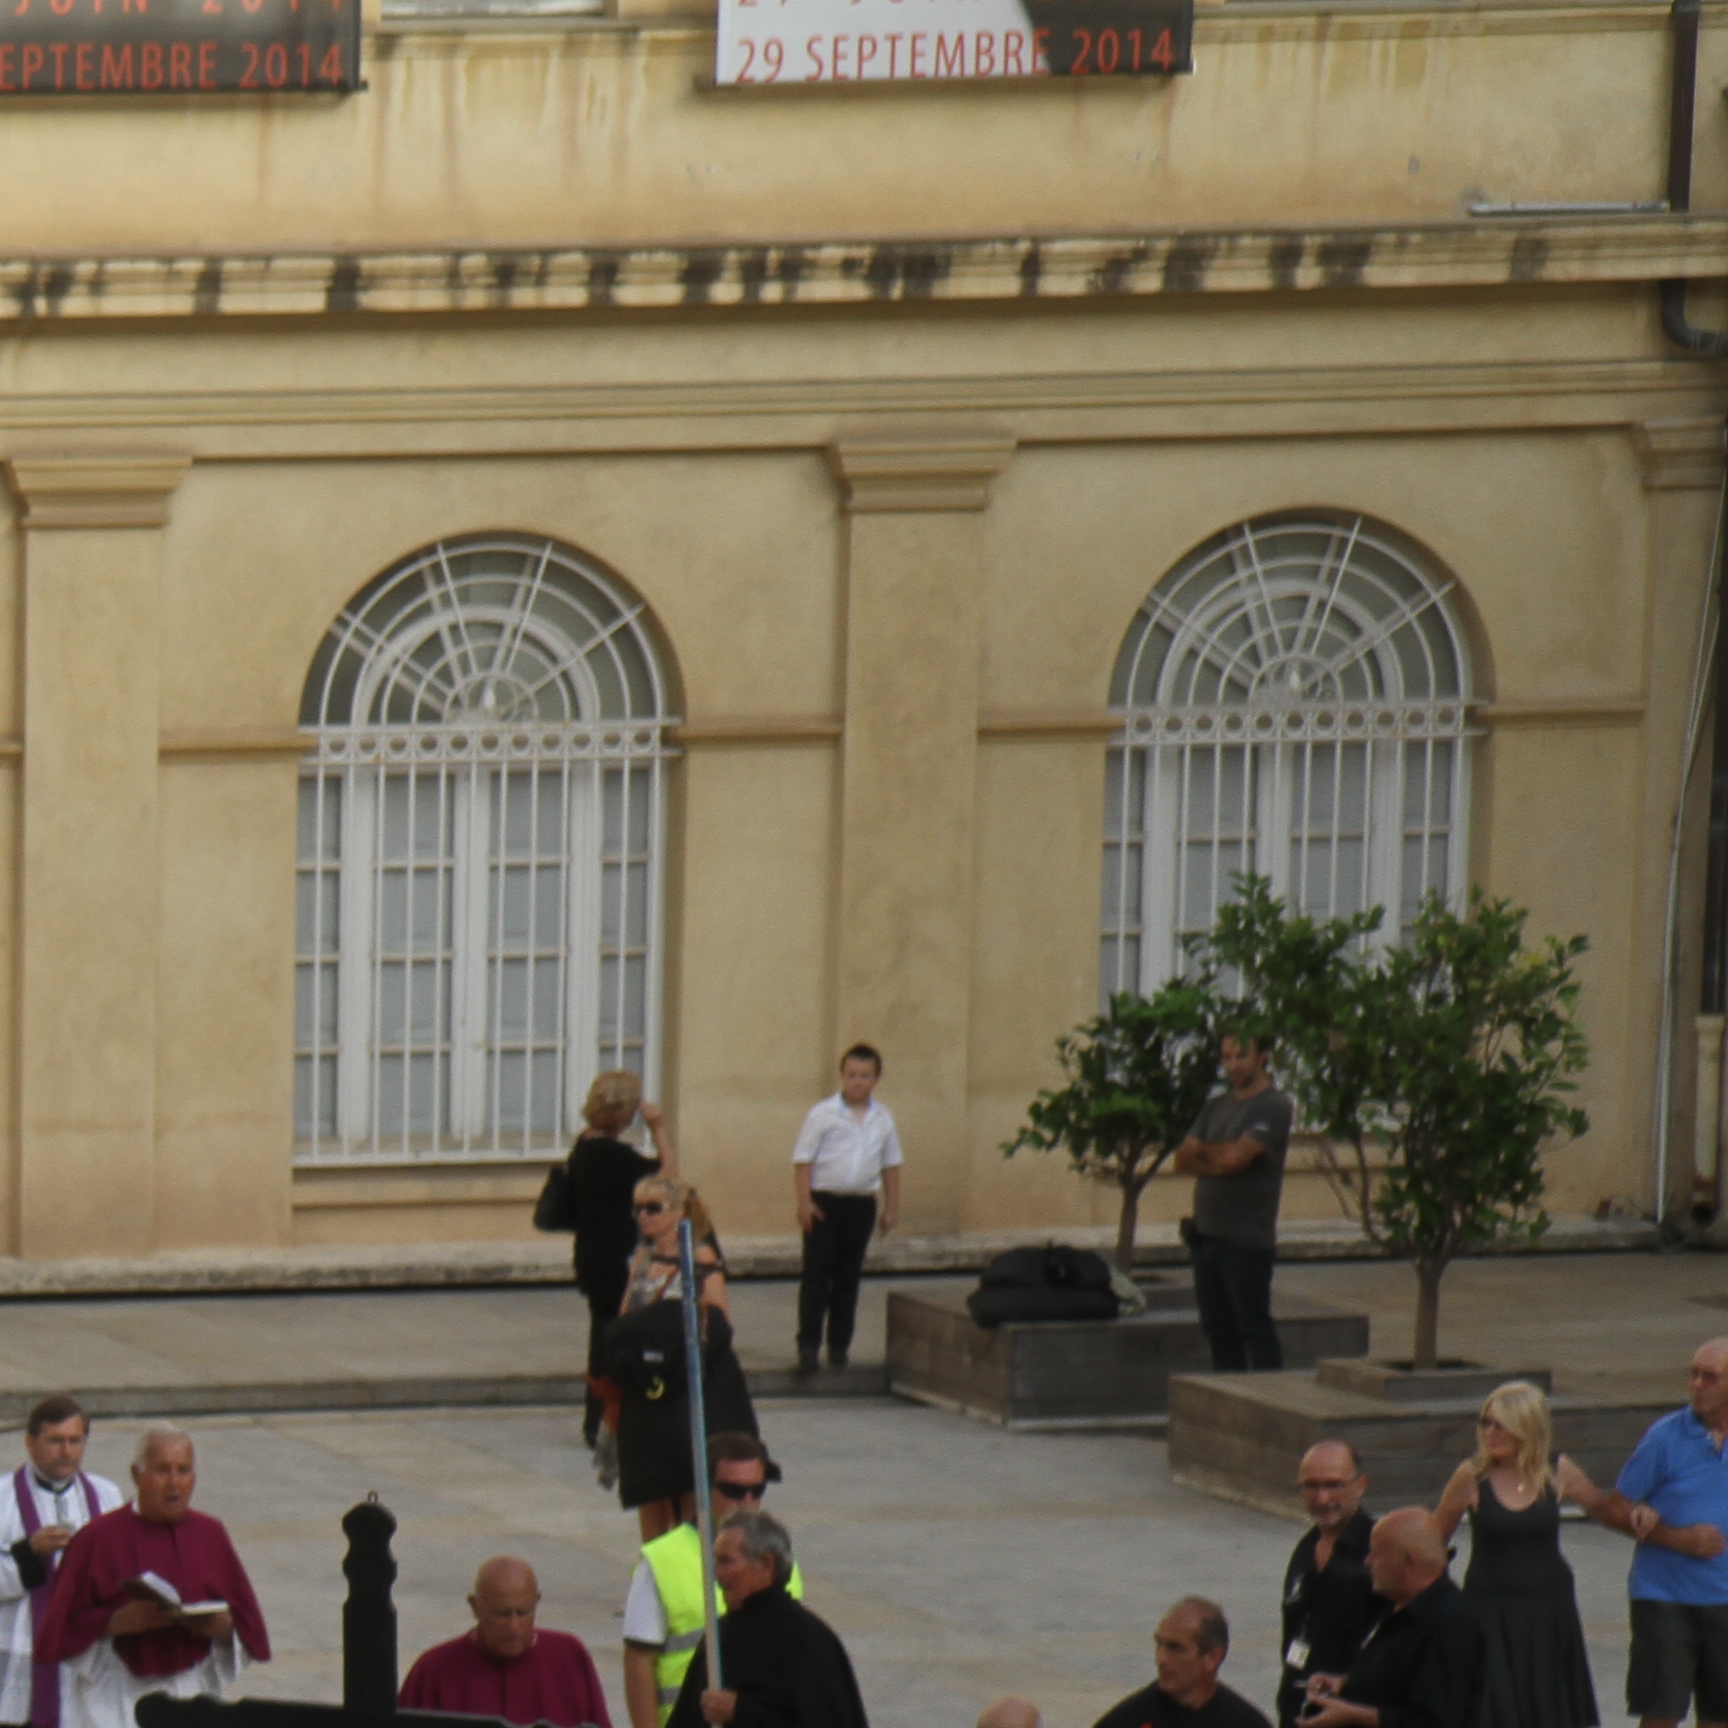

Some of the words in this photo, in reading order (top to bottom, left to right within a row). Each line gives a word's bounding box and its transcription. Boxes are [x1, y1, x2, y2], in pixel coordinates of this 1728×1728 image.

[237, 42, 344, 90] 2014
[736, 37, 784, 83] 29
[805, 27, 1052, 82] SEPTEMBRE
[1070, 27, 1174, 75] 2014
